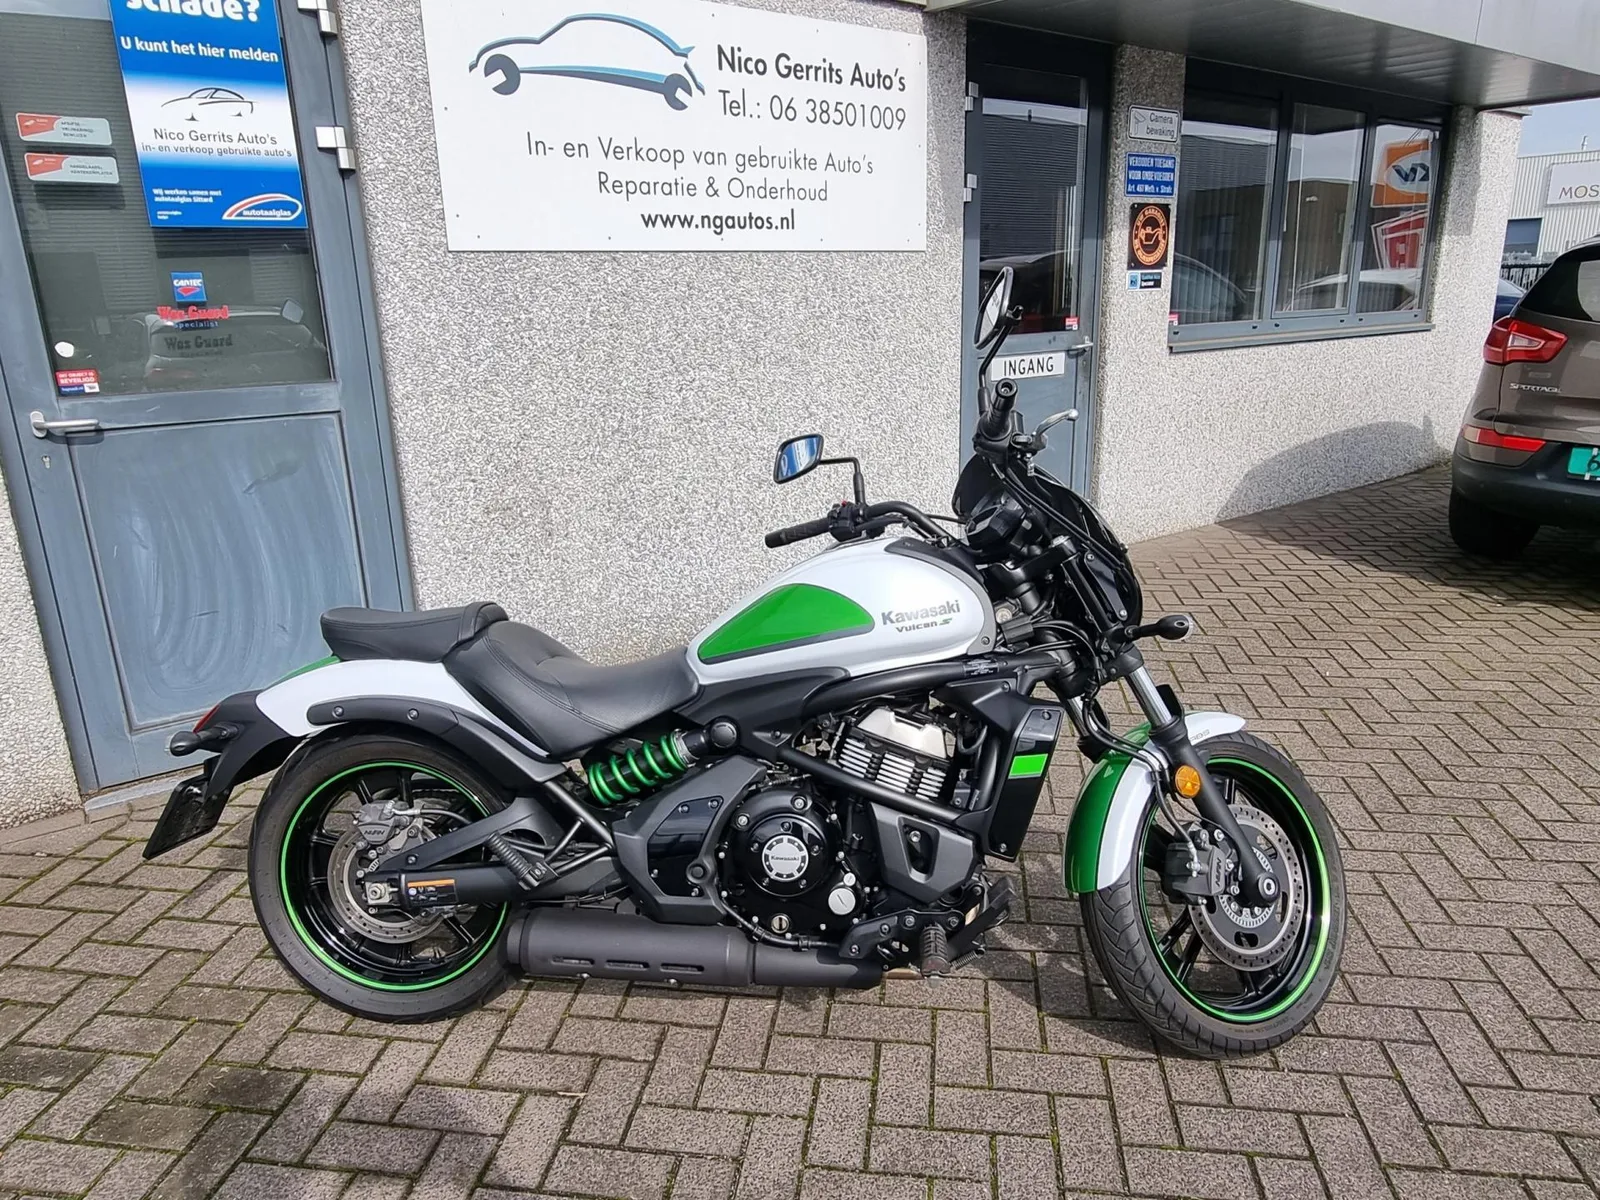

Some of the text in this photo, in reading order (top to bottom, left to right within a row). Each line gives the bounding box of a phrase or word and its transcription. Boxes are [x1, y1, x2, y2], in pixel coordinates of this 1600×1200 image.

[120, 36, 279, 63] U kunt het hier melden
[717, 44, 906, 92] Nico Gerrits Auto's
[719, 88, 906, 131] Tel.: 06 38501009
[1150, 112, 1173, 124] Camera
[153, 128, 278, 145] Nico Gerrits Auto's
[1146, 125, 1174, 139] bewaking
[141, 142, 292, 157] in- en verkoop gebruikte auto's
[527, 131, 874, 174] In- en Verkoop van gebruikte Auto's
[598, 172, 828, 202] Reparatie & Onderhoud
[243, 209, 292, 218] autotaalglas
[640, 208, 795, 236] www.ngautos.nl
[188, 304, 229, 320] Guard
[1004, 357, 1054, 376] INGANG
[881, 600, 961, 625] Kawasaki
[895, 619, 938, 633] Vulcan
